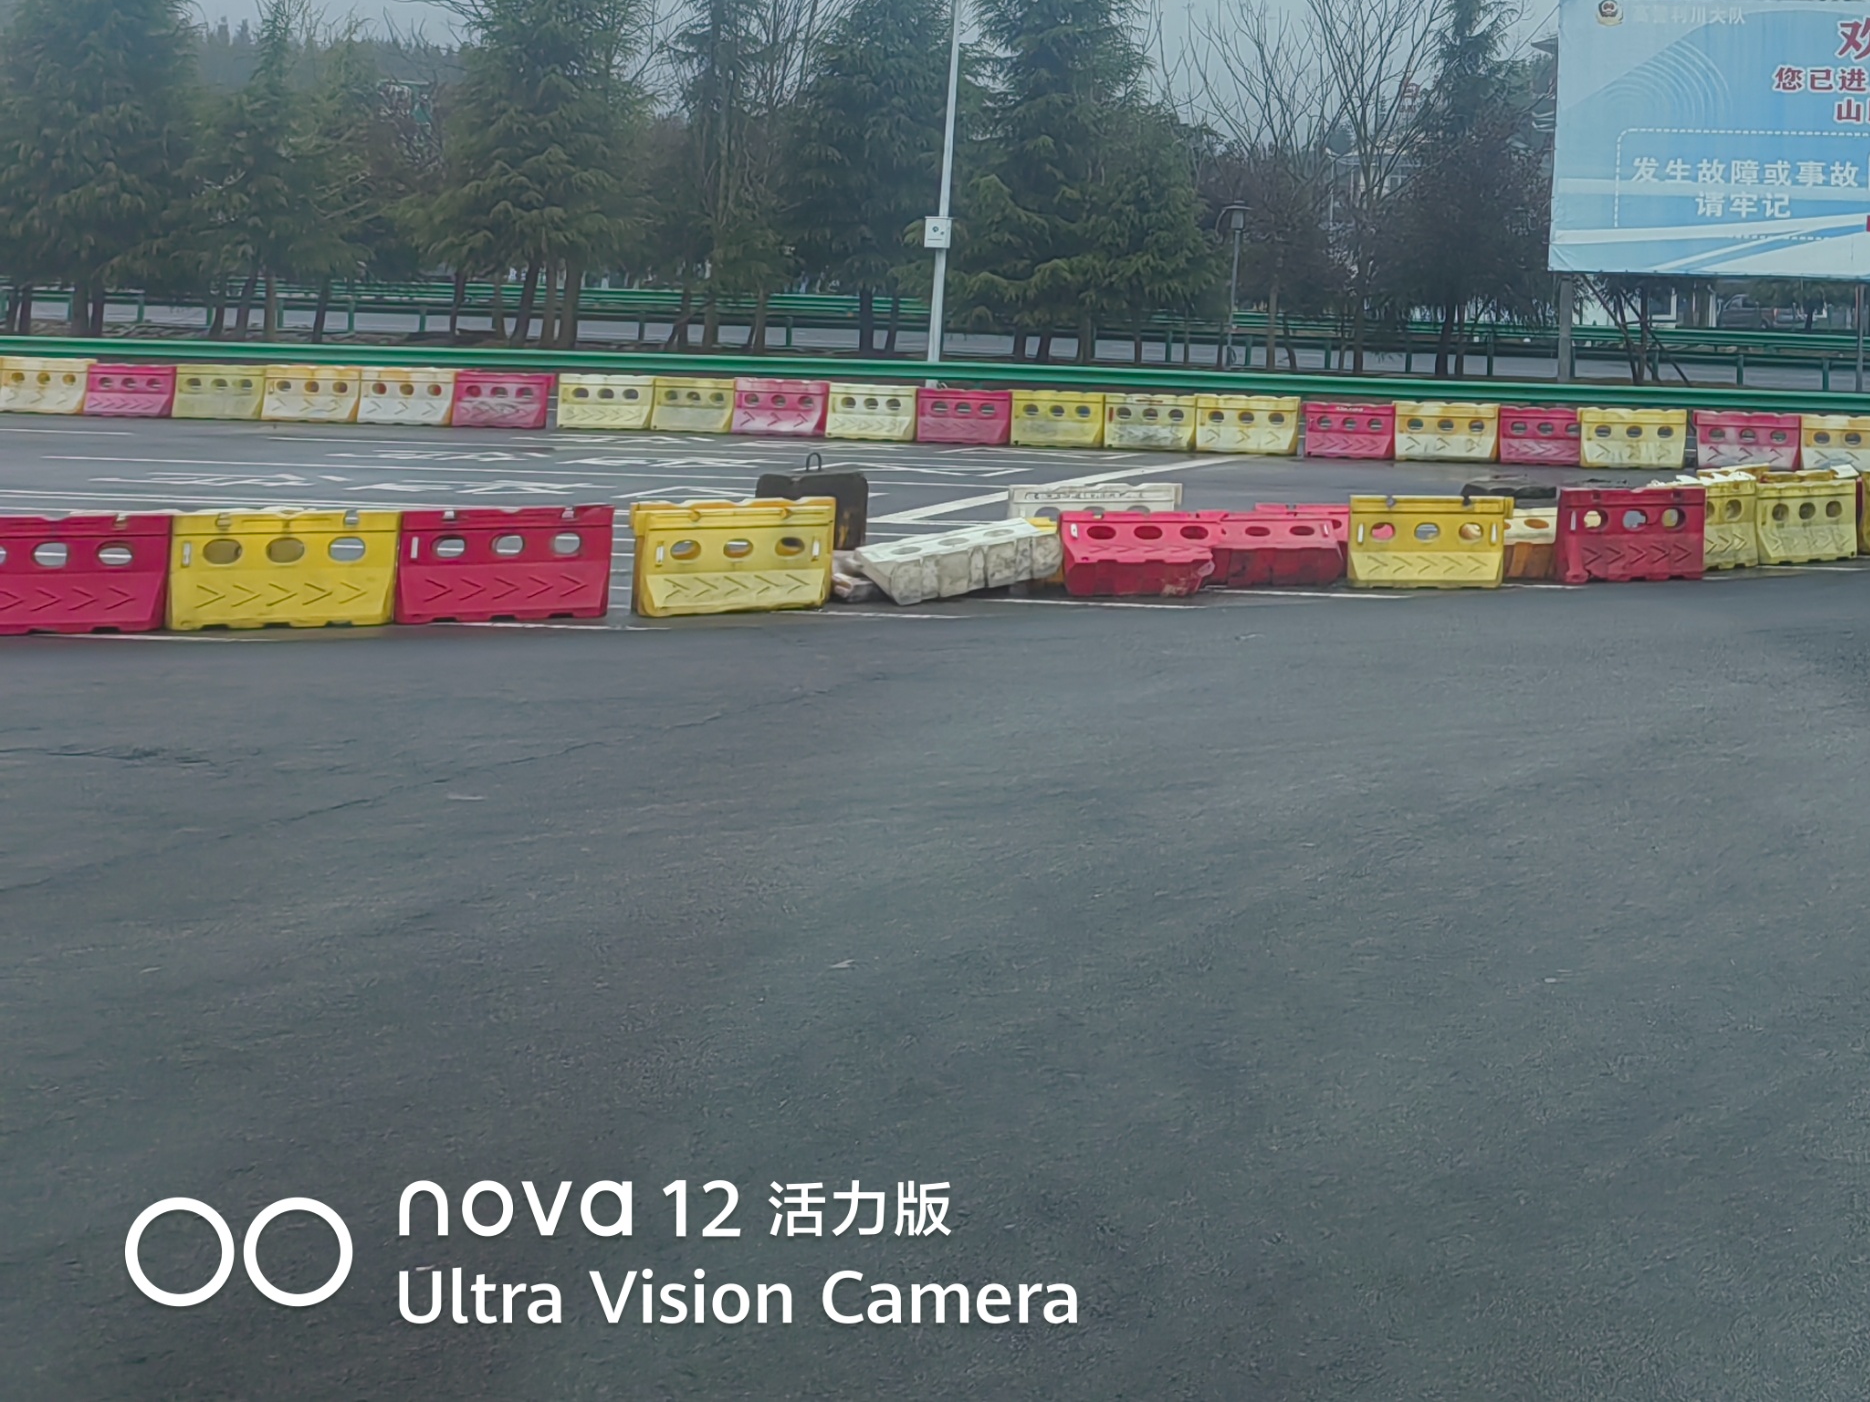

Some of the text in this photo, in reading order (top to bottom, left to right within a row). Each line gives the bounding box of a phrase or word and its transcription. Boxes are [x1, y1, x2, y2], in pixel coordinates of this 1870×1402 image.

[1632, 157, 1859, 188] 发生故障或事故
[1695, 192, 1791, 219] 请牢记
